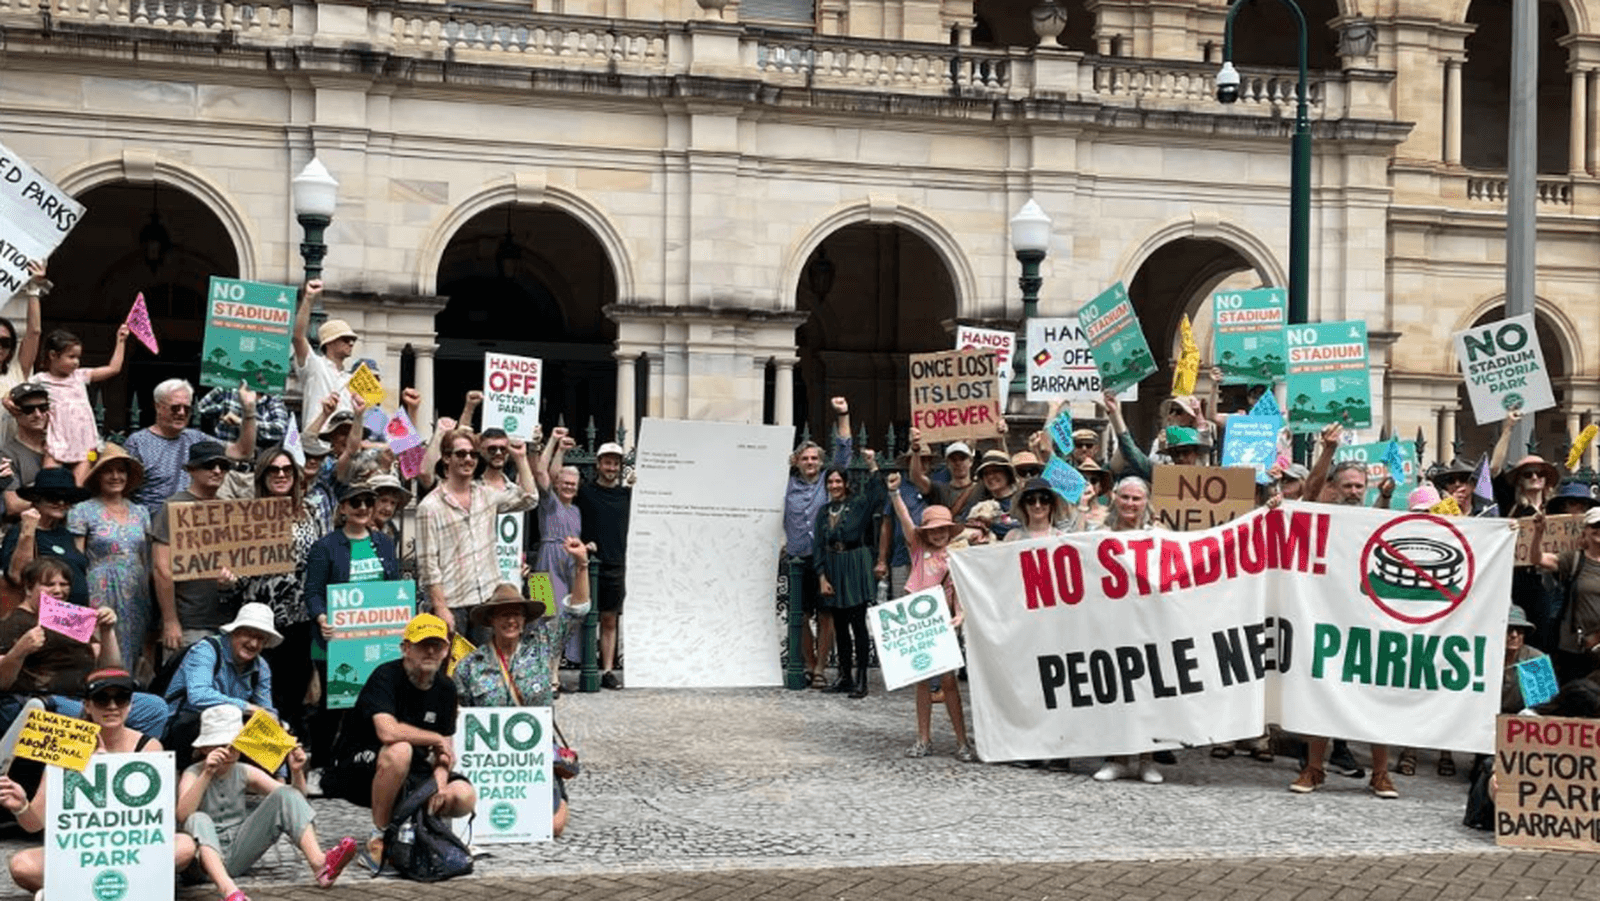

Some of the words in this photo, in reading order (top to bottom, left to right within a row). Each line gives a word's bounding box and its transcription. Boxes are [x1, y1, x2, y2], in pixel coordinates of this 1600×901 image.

[22, 181, 77, 232] PARKS
[214, 282, 245, 300] NO
[214, 302, 288, 322] STADIUM
[1216, 295, 1242, 309] NO
[1080, 304, 1099, 325] NO
[1088, 303, 1128, 337] STADIUM
[1220, 309, 1280, 323] STADIUM
[962, 332, 1010, 347] HANDS
[1287, 328, 1317, 345] NO
[1463, 323, 1528, 362] NO
[1291, 345, 1362, 361] STADIUM
[1469, 349, 1535, 374] STADIUM
[490, 358, 538, 374] HANDS
[911, 358, 953, 379] ONCE
[1471, 361, 1540, 386] VICTORIA
[489, 371, 538, 395] OFF
[947, 380, 992, 402] LOST
[1489, 376, 1527, 393] PARK
[489, 393, 535, 406] VICTORIA
[498, 404, 525, 415] PARK
[1341, 449, 1368, 462] NO
[1178, 474, 1227, 504] NO
[176, 503, 234, 528] KEEP
[238, 498, 295, 522] YOUR
[175, 522, 285, 550] PROMISE!!
[497, 514, 518, 544] O
[173, 551, 223, 575] SAVE
[229, 547, 256, 568] VIC
[259, 543, 296, 565] PARK
[1020, 544, 1085, 610] NO
[1097, 510, 1330, 600] STADIUM!
[331, 588, 364, 608] NO
[335, 608, 409, 626] STADIUM
[879, 595, 938, 631] NO
[881, 615, 945, 642] STADIUM
[882, 625, 948, 651] VICTORIA
[900, 638, 937, 656] PARK
[1037, 637, 1204, 710] PEOPLE
[1311, 622, 1487, 693] PARKS!
[28, 711, 72, 729] ALWAYS
[465, 713, 542, 751] NO
[461, 752, 545, 768] STADIUM
[1500, 750, 1598, 780] VICTOR
[63, 761, 161, 810] NO
[480, 785, 527, 800] PARK
[58, 809, 163, 830] STADIUM
[56, 828, 165, 849] VICTORIA
[81, 849, 140, 867] PARK
